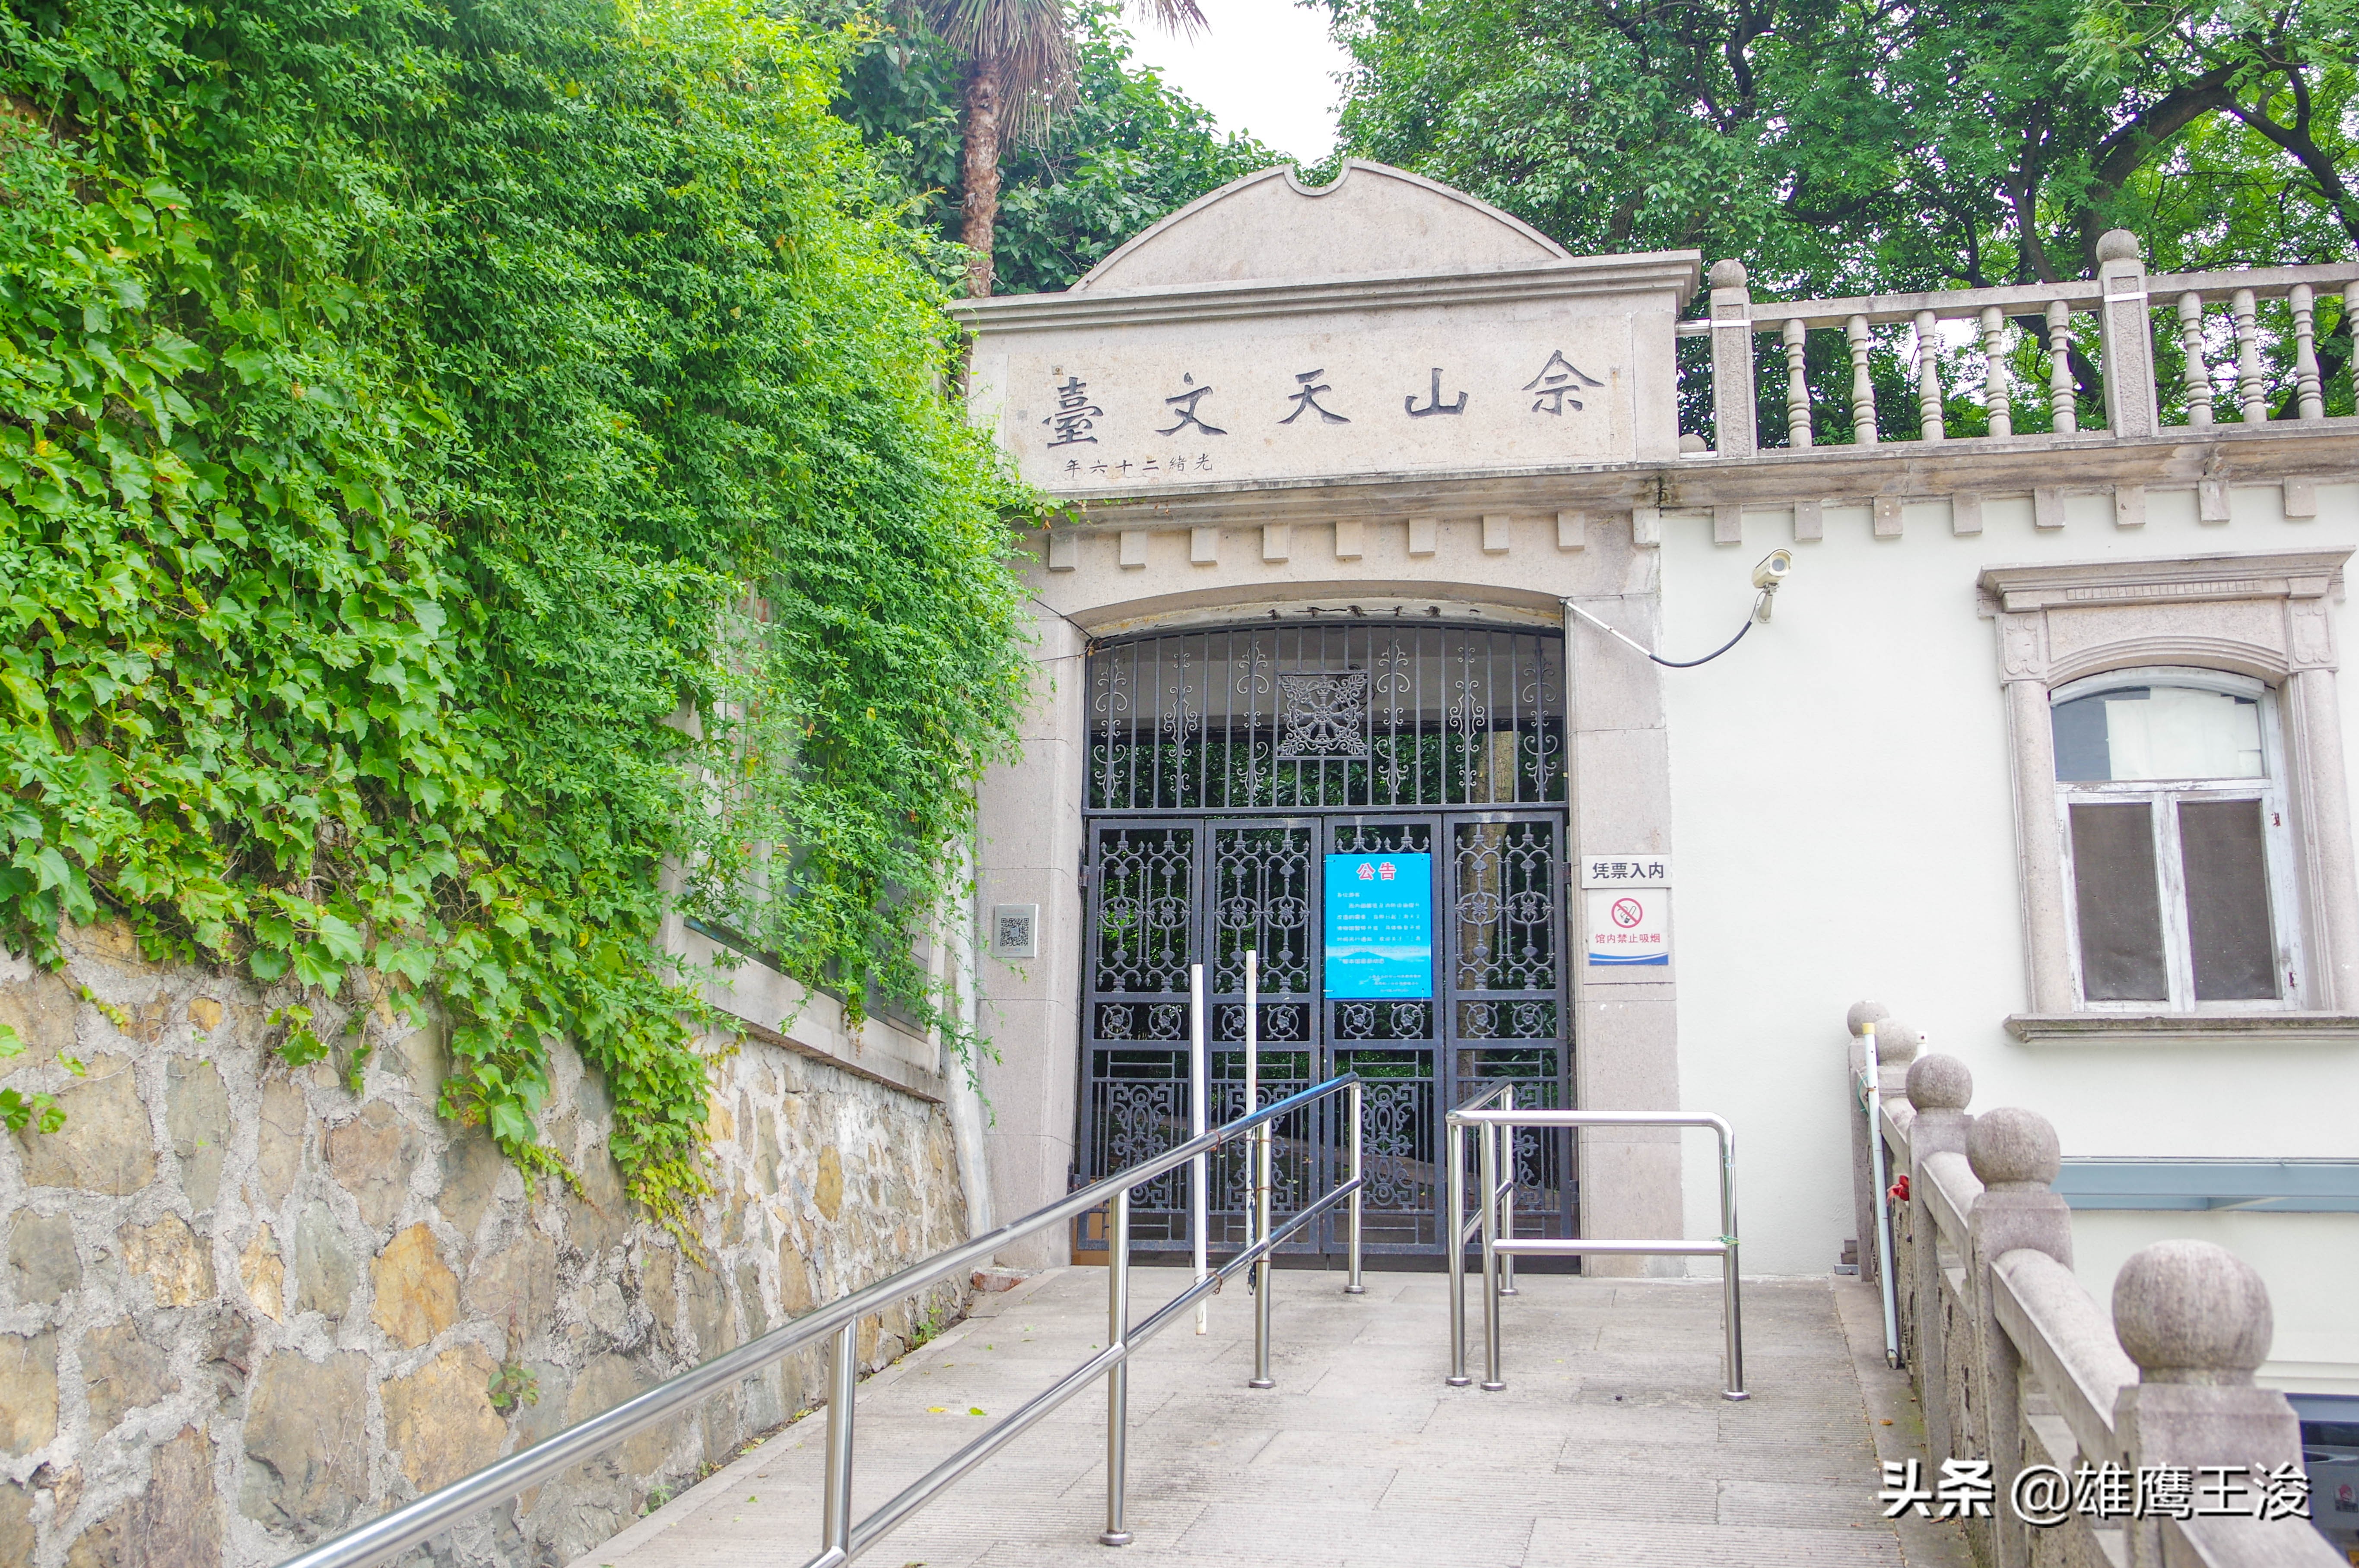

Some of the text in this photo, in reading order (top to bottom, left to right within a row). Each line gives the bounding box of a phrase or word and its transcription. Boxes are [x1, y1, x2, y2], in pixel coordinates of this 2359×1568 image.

[1356, 862, 1397, 881] 公告
[1592, 862, 1664, 879] 凭票入内
[1595, 933, 1661, 944] 馆内禁止吸烟
